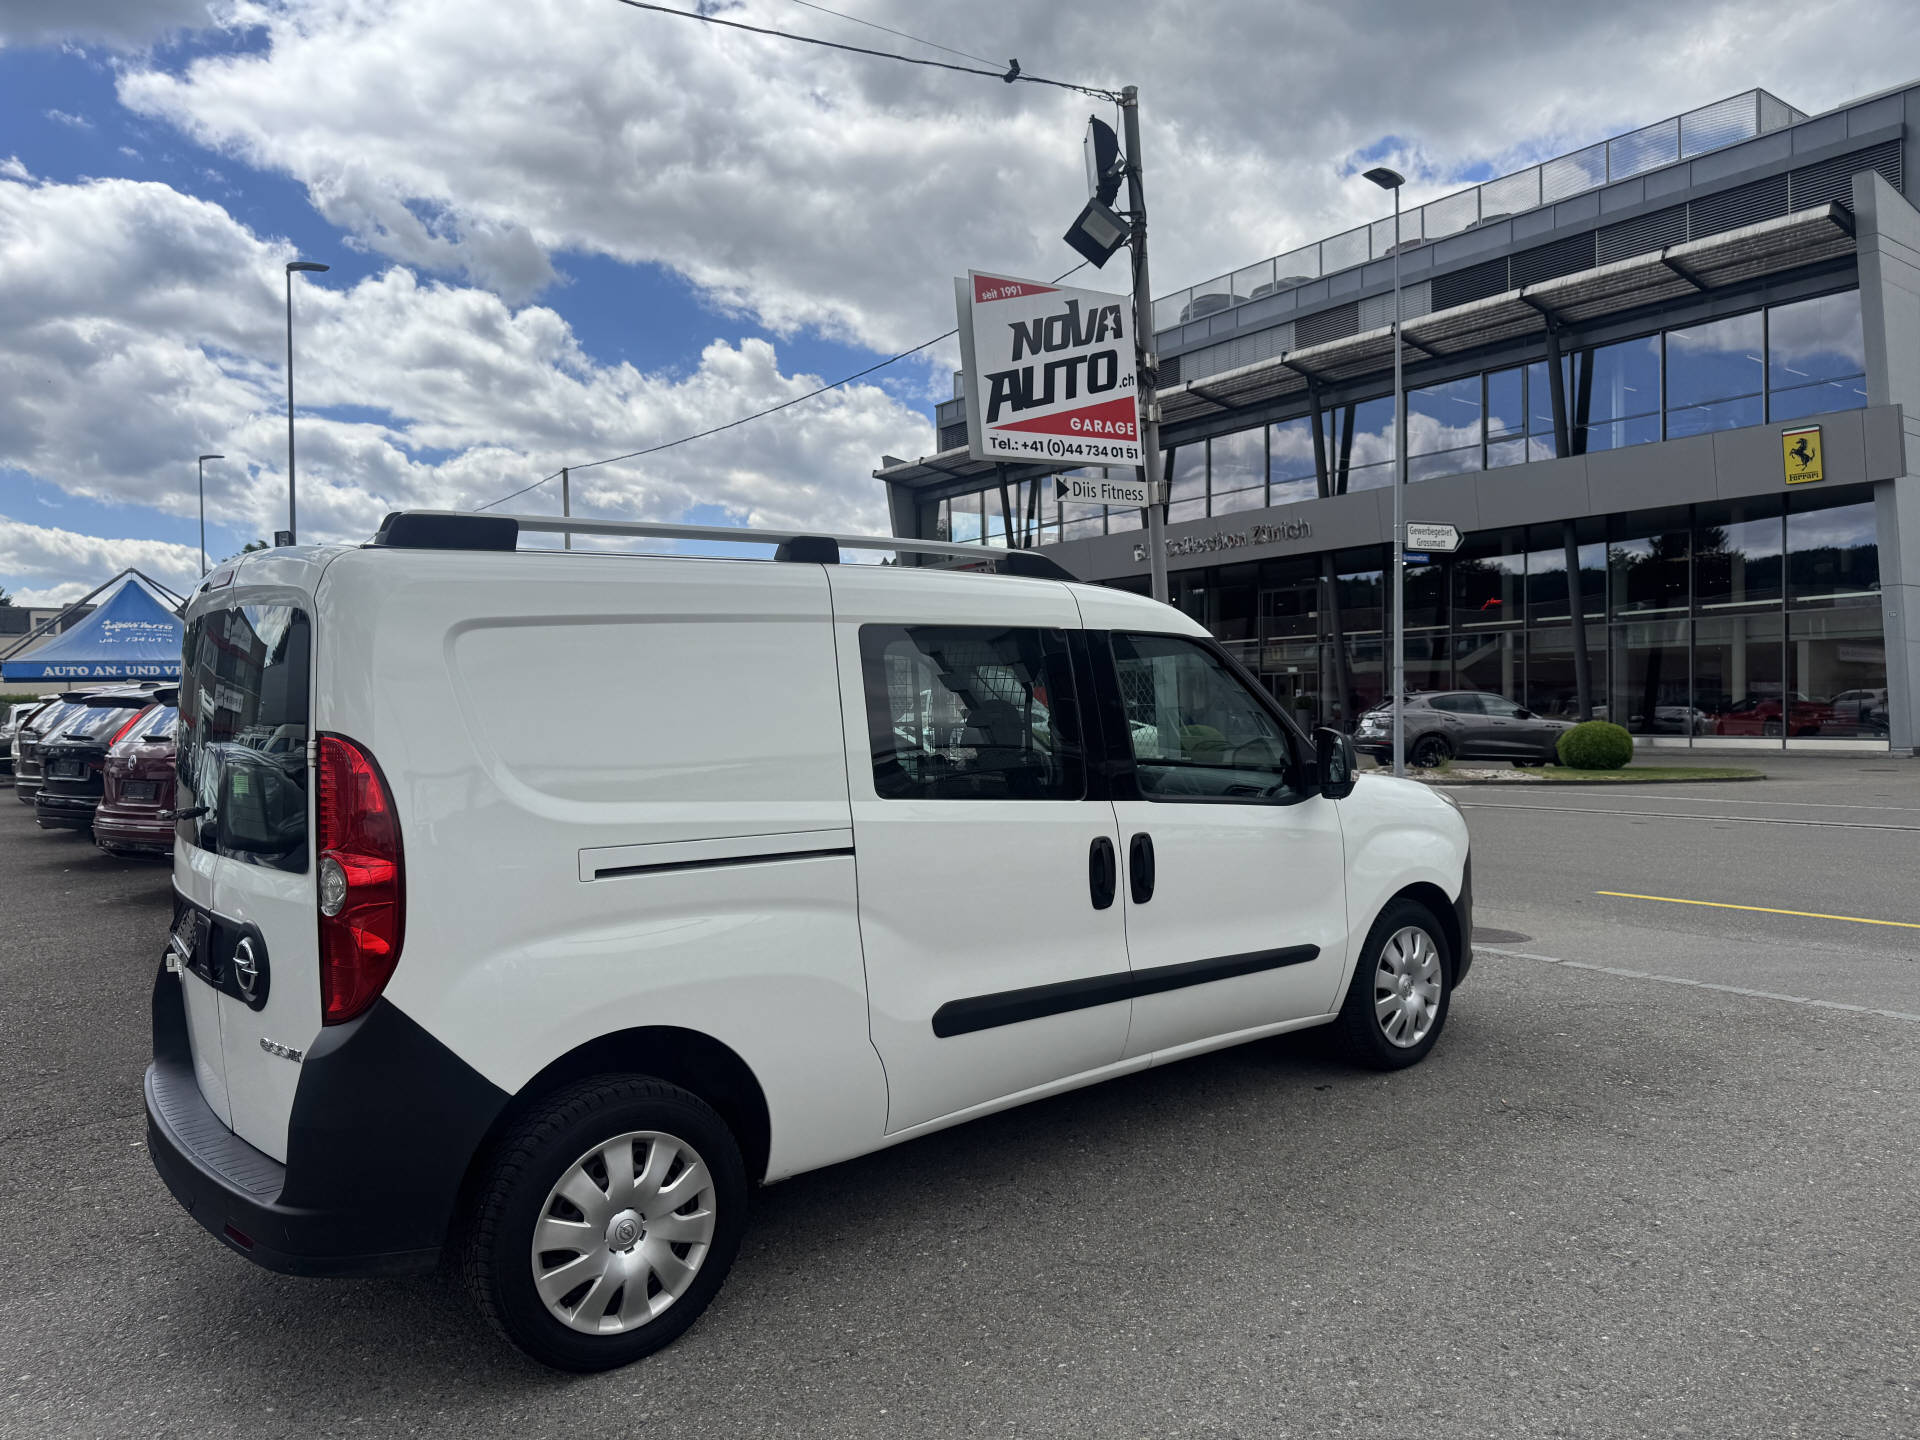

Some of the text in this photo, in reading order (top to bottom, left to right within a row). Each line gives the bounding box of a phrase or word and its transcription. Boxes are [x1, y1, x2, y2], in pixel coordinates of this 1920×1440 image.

[981, 285, 1022, 300] seit 1991
[1008, 299, 1123, 361] NOVA
[1070, 417, 1135, 436] GARAGE
[990, 437, 1138, 460] Tel.: +41 (0)44 734 01 51
[1789, 471, 1819, 482] Ferrari
[1072, 481, 1144, 501] Diis Fitness
[1251, 518, 1312, 545] Zürich
[1409, 526, 1453, 538] Gewerbegebiet
[42, 666, 89, 676] AUTO
[93, 666, 122, 676] AN-
[125, 666, 161, 676] UND
